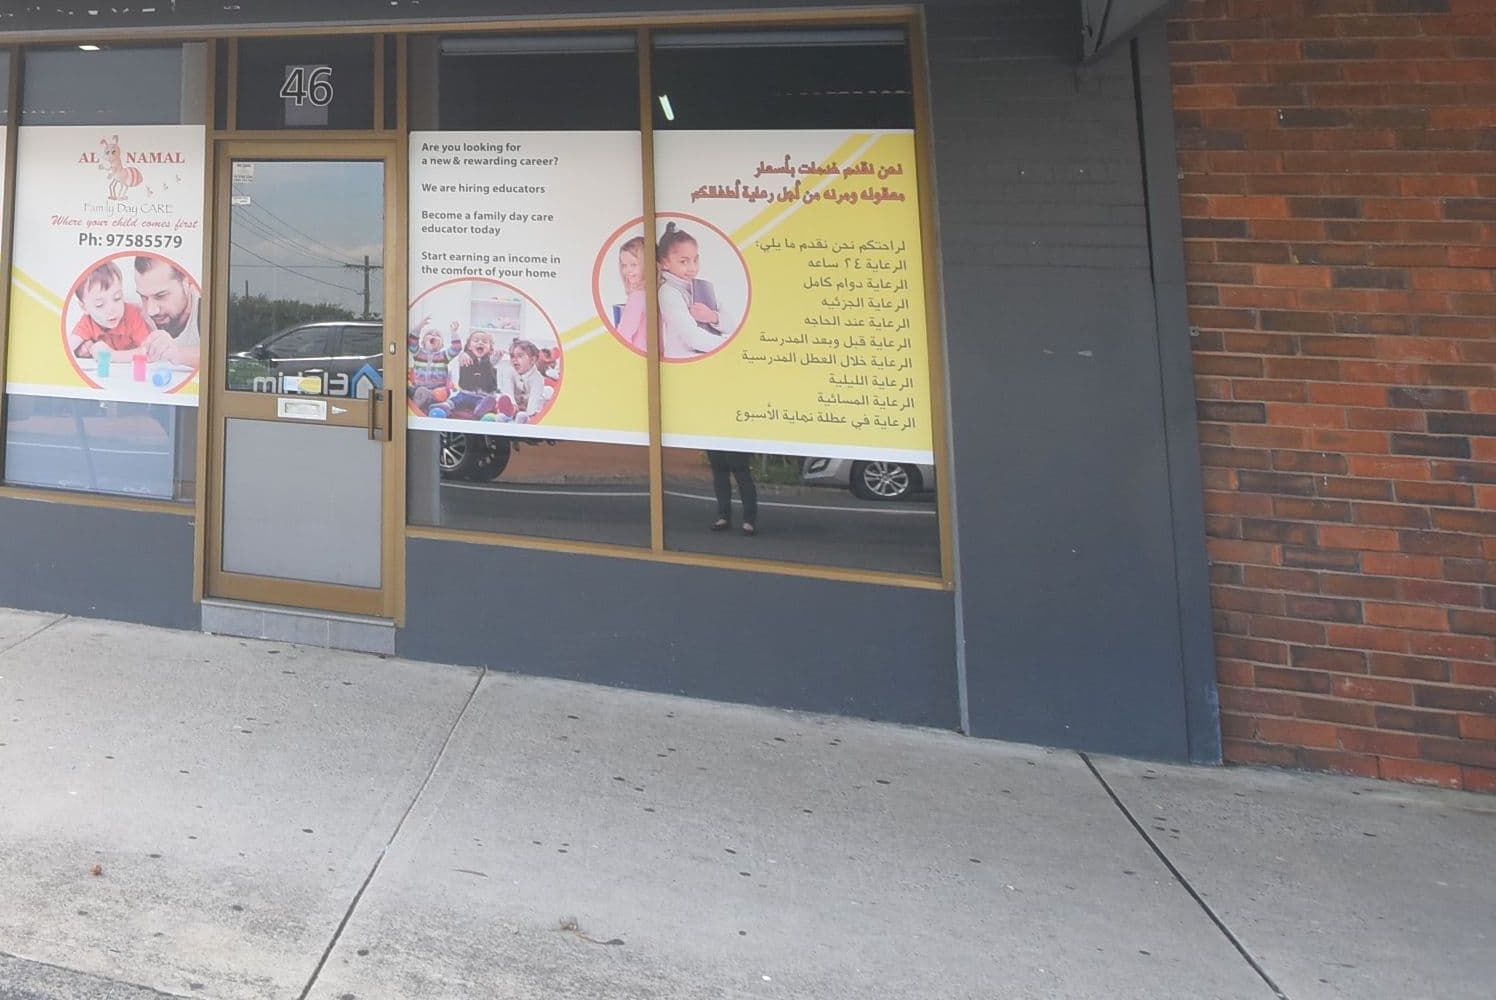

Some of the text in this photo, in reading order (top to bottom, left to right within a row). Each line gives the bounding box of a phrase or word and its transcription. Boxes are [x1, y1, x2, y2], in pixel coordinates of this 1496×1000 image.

[280, 67, 334, 107] 46
[422, 142, 521, 154] Are you looking for
[78, 152, 185, 164] AL NAMAL
[422, 157, 559, 168] a new & rewarding career?
[422, 183, 546, 195] We are hiring educators
[51, 215, 198, 230] Where your child comes first
[422, 211, 554, 224] Become a family day care
[422, 224, 500, 237] educator today
[79, 233, 183, 248] Ph: 97585579
[755, 238, 906, 253] لراحتكم نحن نقدم ما يلي:
[422, 252, 561, 265] Start earning an income in
[808, 258, 838, 269] ساعه
[865, 259, 907, 272] الرعاية
[421, 265, 557, 280] the comfort of your home
[803, 277, 908, 291] الرعاية دوام كامل
[821, 297, 909, 312] الرعاية الجزئيه
[804, 316, 910, 331] الرعاية عند الحاجه
[760, 331, 911, 351] الرعاية قبل وبعد المدرسة
[742, 352, 912, 370] الرعاية خلال العطل المدرسية
[828, 373, 913, 390] الرعاية الليلية
[818, 391, 915, 410] الرعاية المسائية
[735, 403, 916, 431] الرعاية في عطلة نهاية الأسبوع
